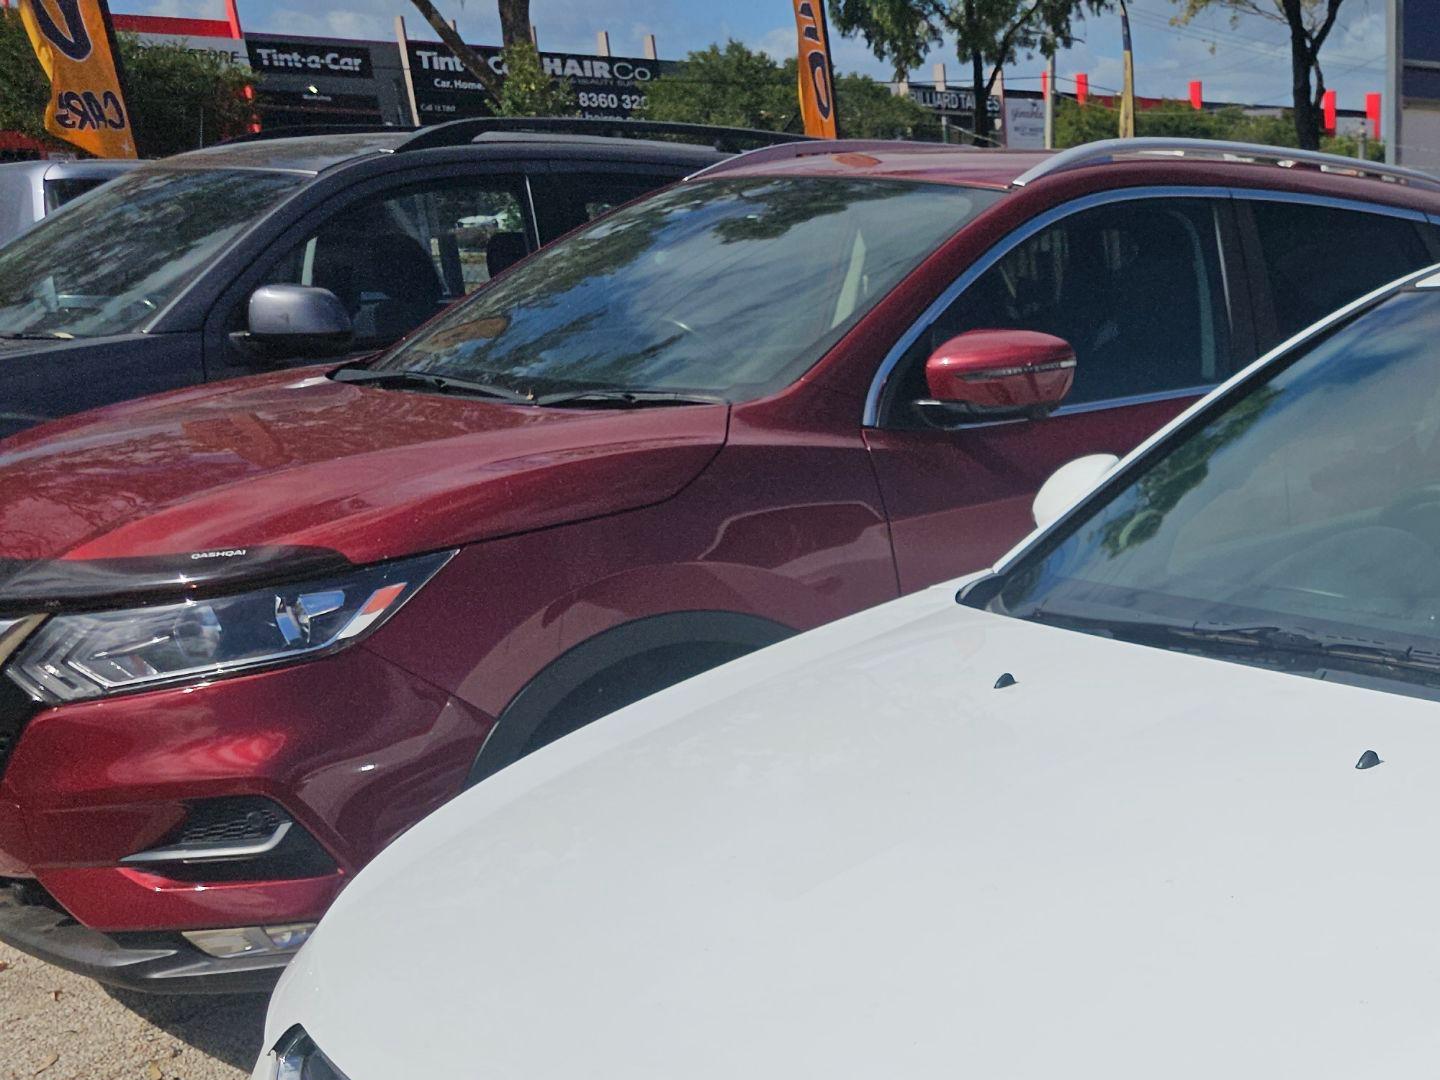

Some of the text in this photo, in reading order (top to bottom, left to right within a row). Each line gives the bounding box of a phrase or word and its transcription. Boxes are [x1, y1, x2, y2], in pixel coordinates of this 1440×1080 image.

[257, 49, 362, 71] Tint-a-Car
[579, 92, 618, 109] 8360
[959, 93, 1000, 112] TAES
[191, 549, 246, 560] QASHQAI
